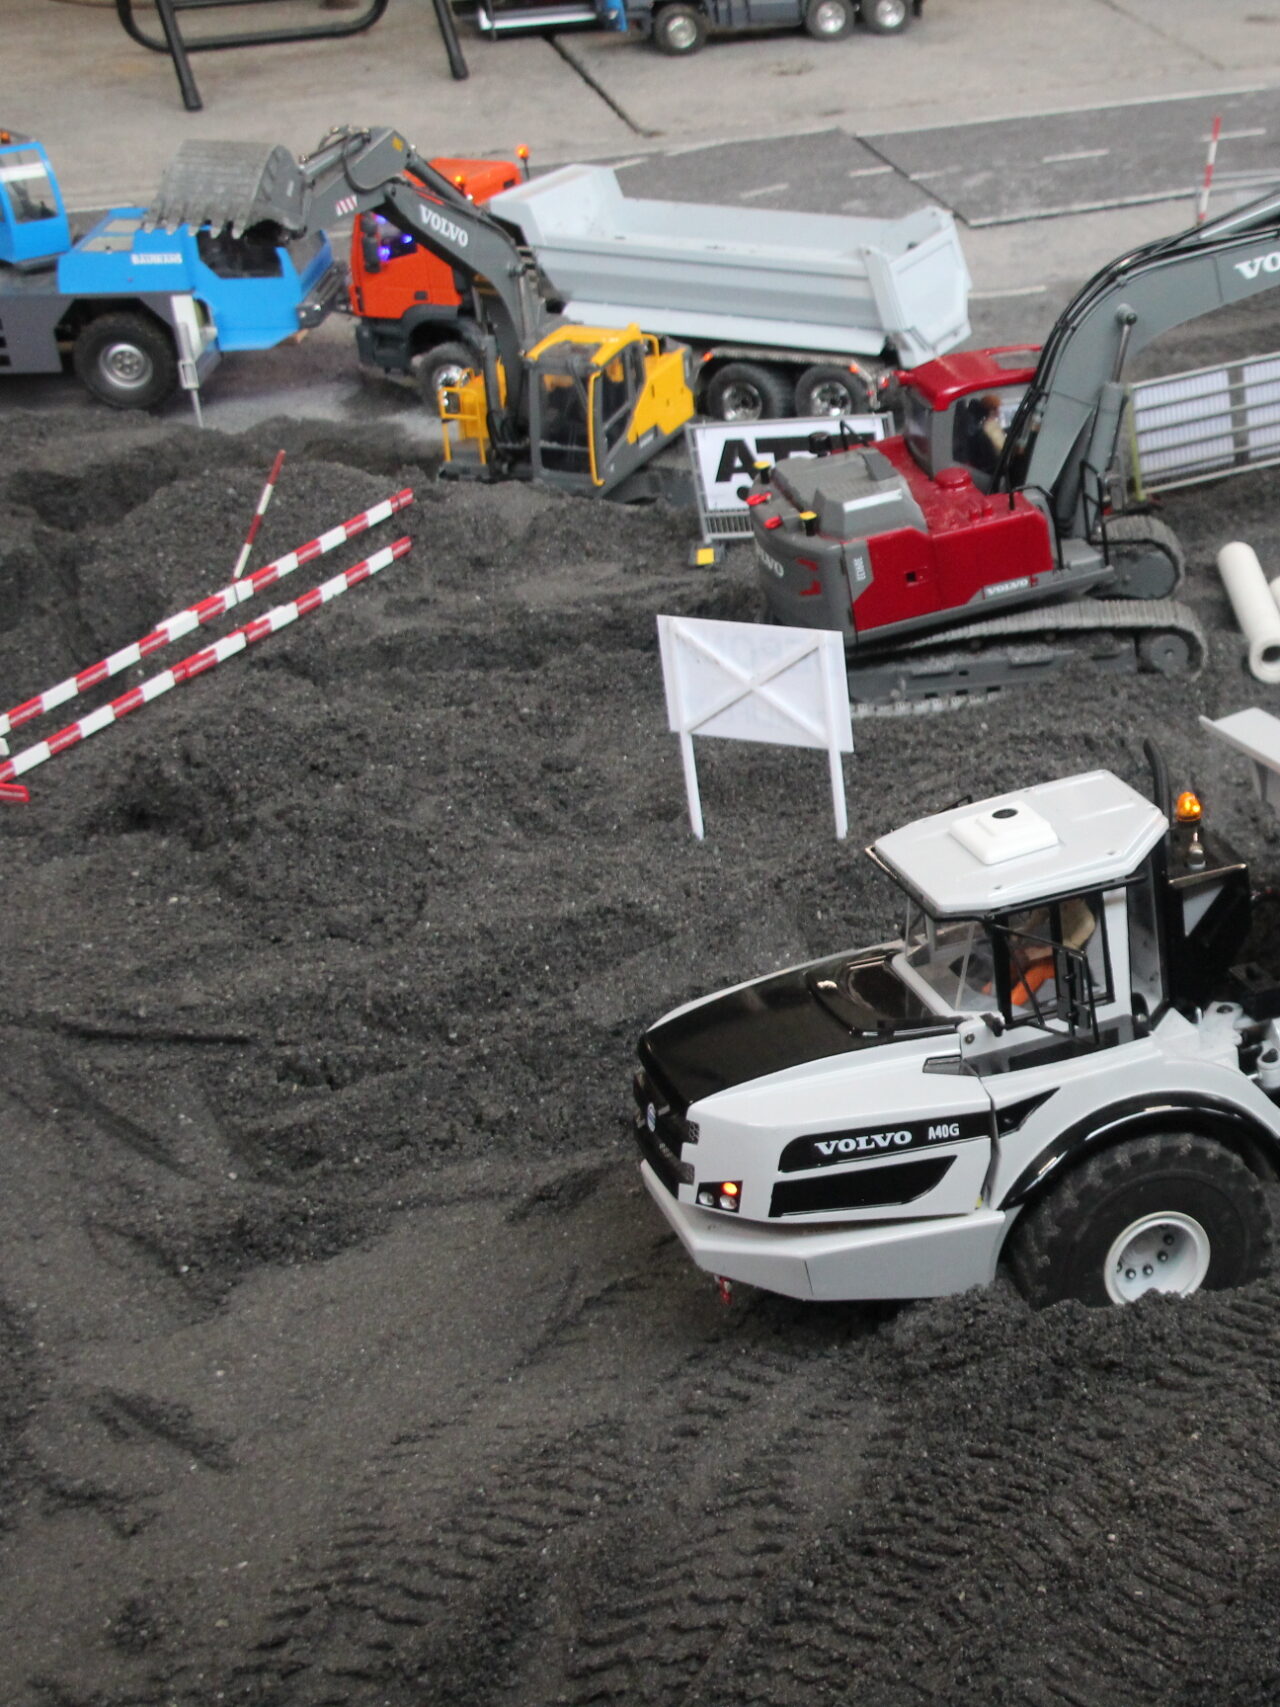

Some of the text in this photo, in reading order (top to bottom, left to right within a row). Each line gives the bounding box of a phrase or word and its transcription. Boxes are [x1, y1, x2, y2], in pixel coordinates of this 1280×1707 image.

[419, 203, 469, 248] VOLVO
[986, 578, 1029, 596] VOLVO
[814, 1123, 960, 1155] VOLVO A40G
